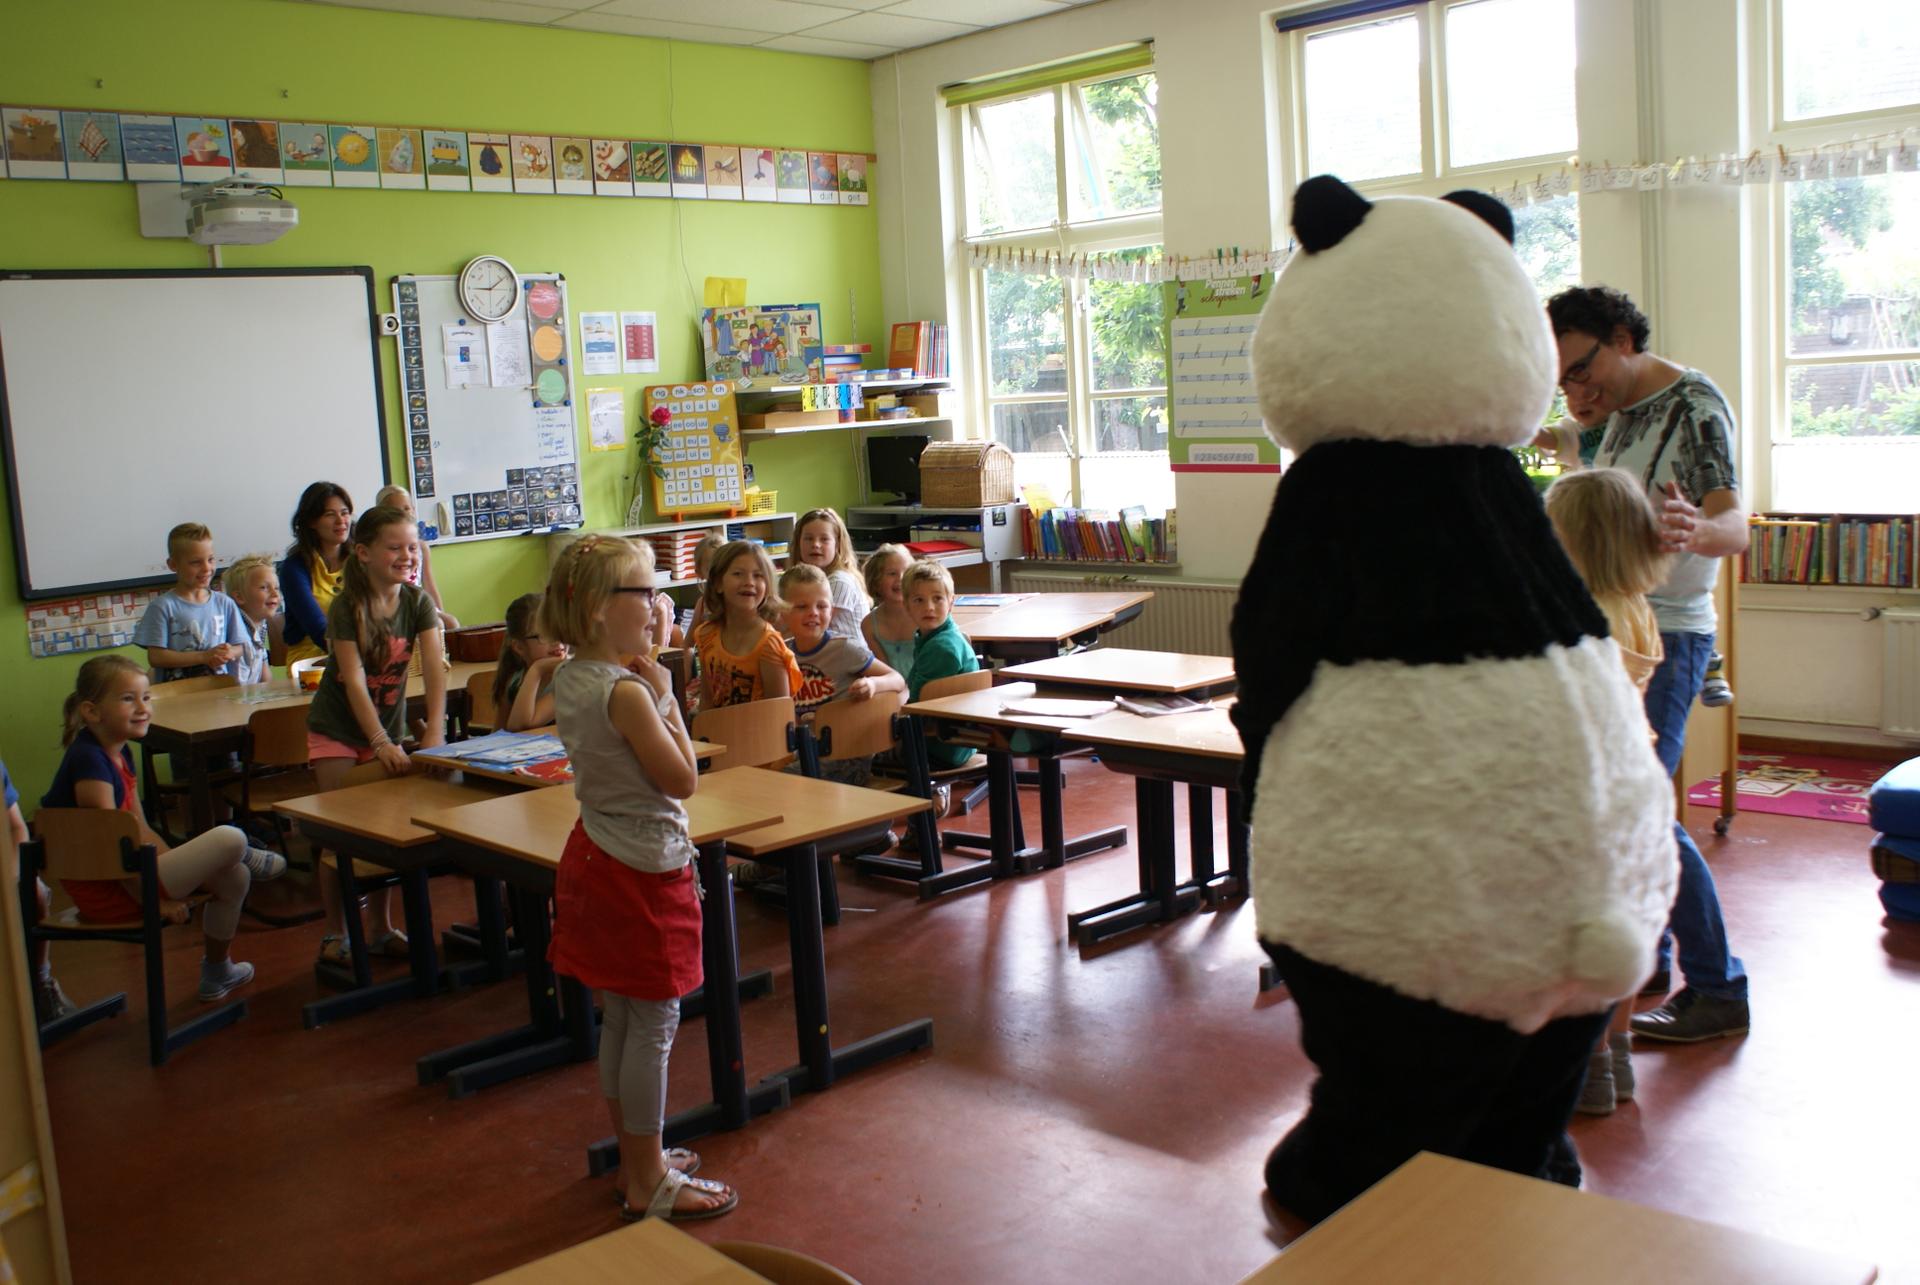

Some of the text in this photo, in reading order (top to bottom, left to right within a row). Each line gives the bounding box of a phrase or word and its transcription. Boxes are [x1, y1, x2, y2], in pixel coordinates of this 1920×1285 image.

[655, 390, 666, 398] ng
[693, 386, 706, 394] sch
[794, 676, 834, 703] AOS
